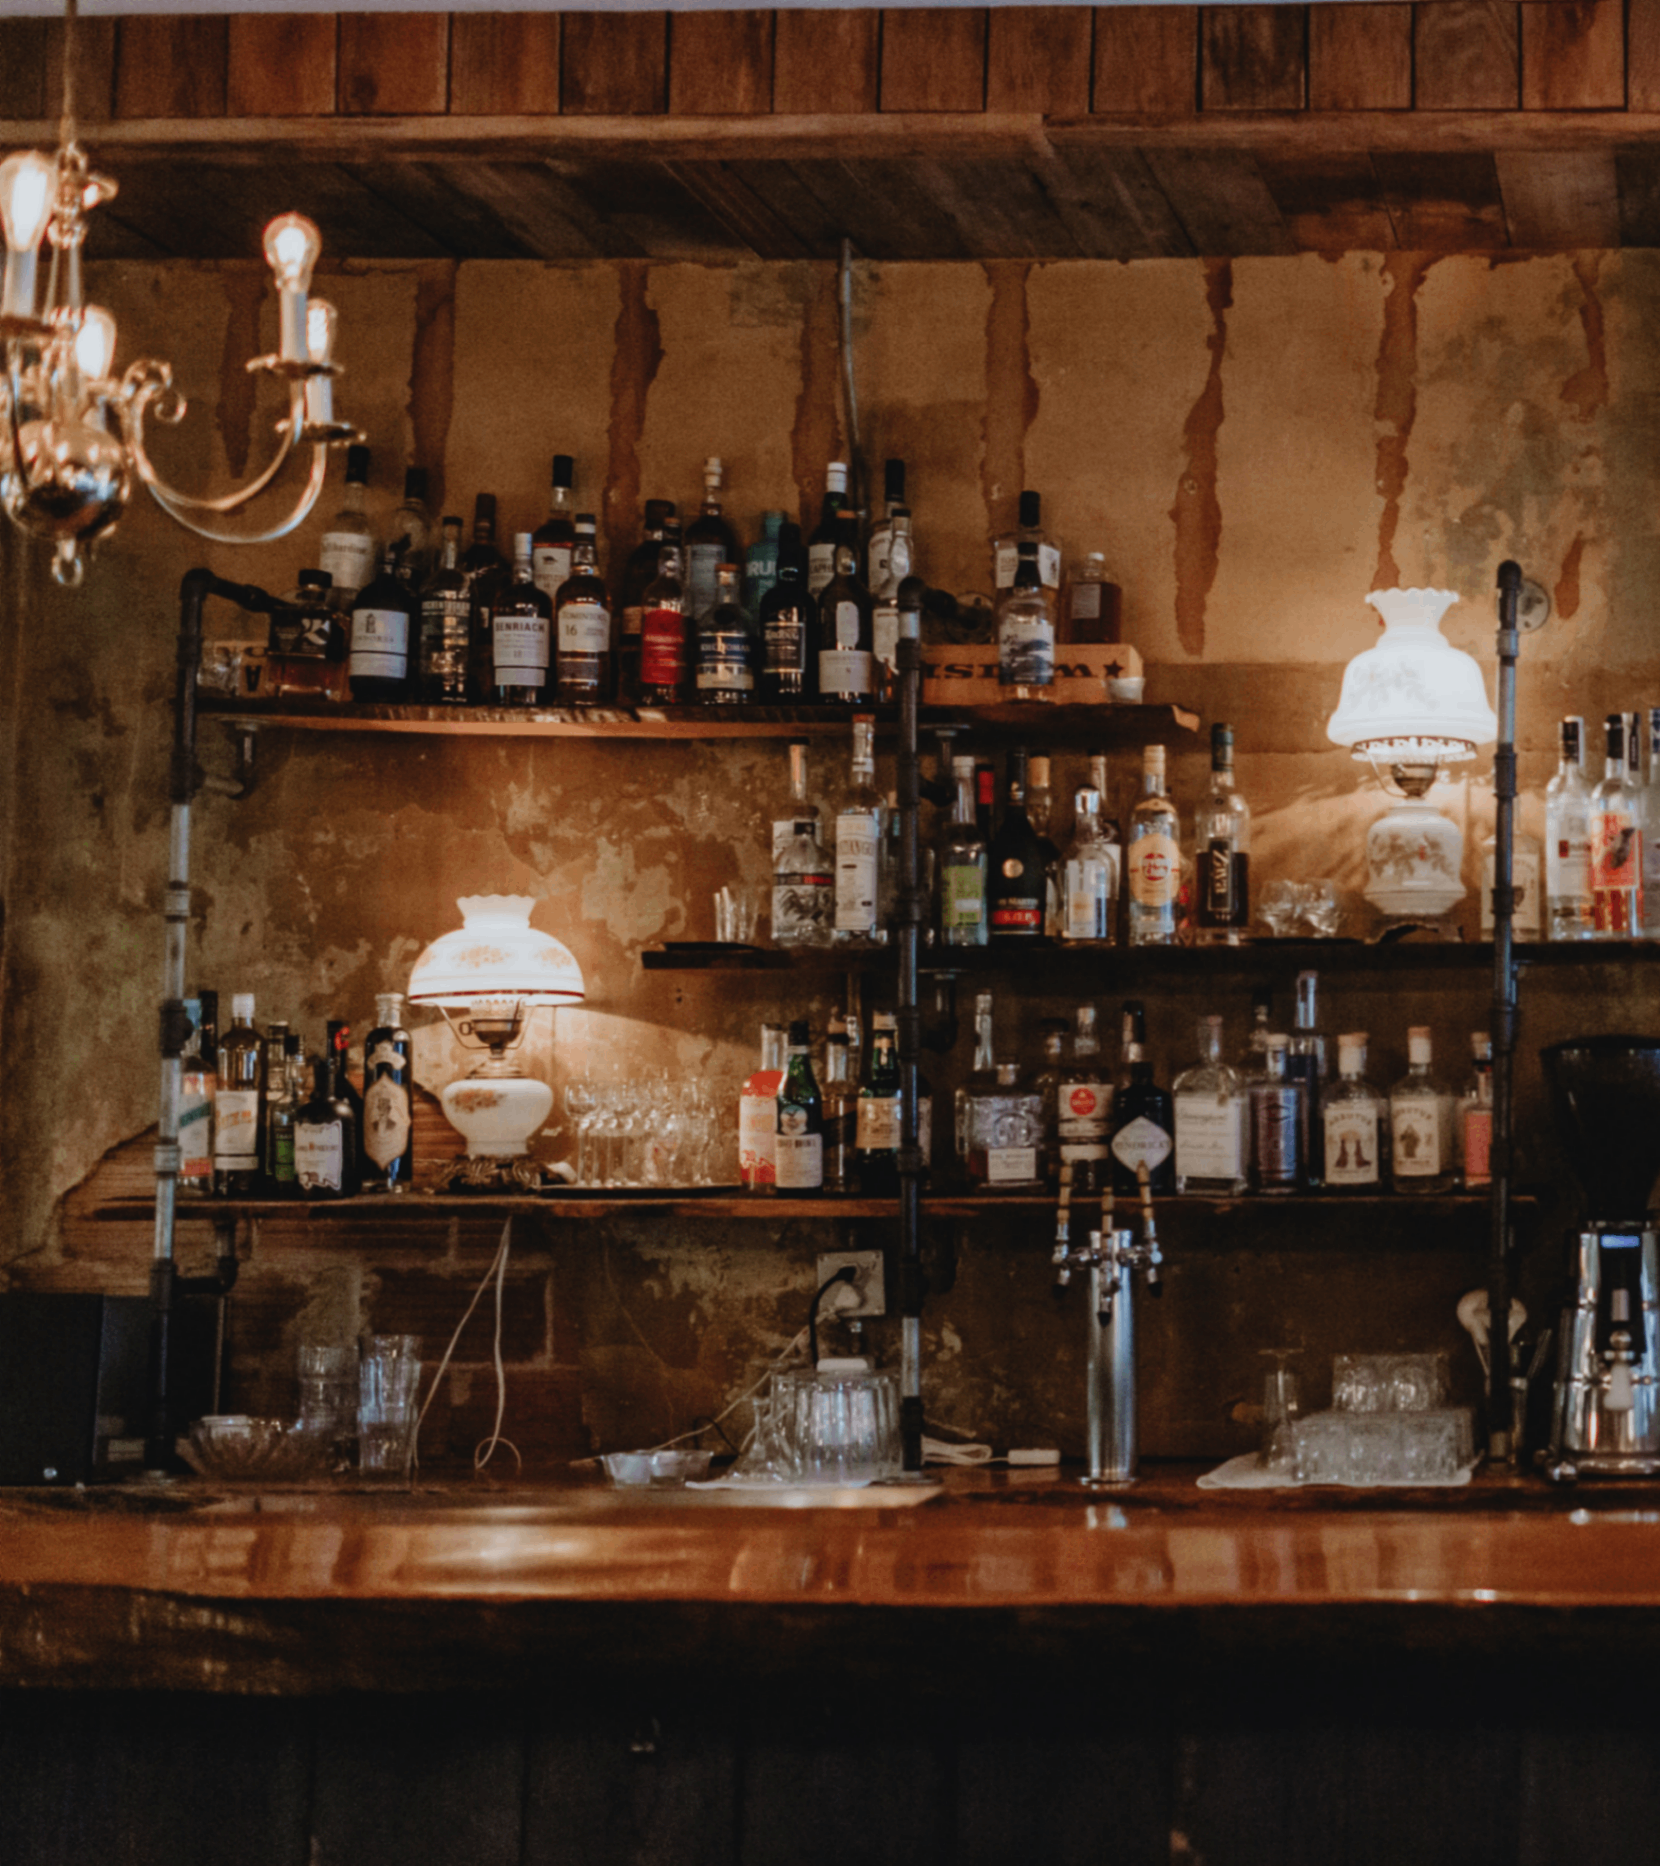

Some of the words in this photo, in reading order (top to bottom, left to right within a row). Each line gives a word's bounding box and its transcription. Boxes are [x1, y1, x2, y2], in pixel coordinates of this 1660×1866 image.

[747, 561, 777, 576] RUI
[495, 621, 546, 634] BENRIACH
[565, 625, 578, 637] 16
